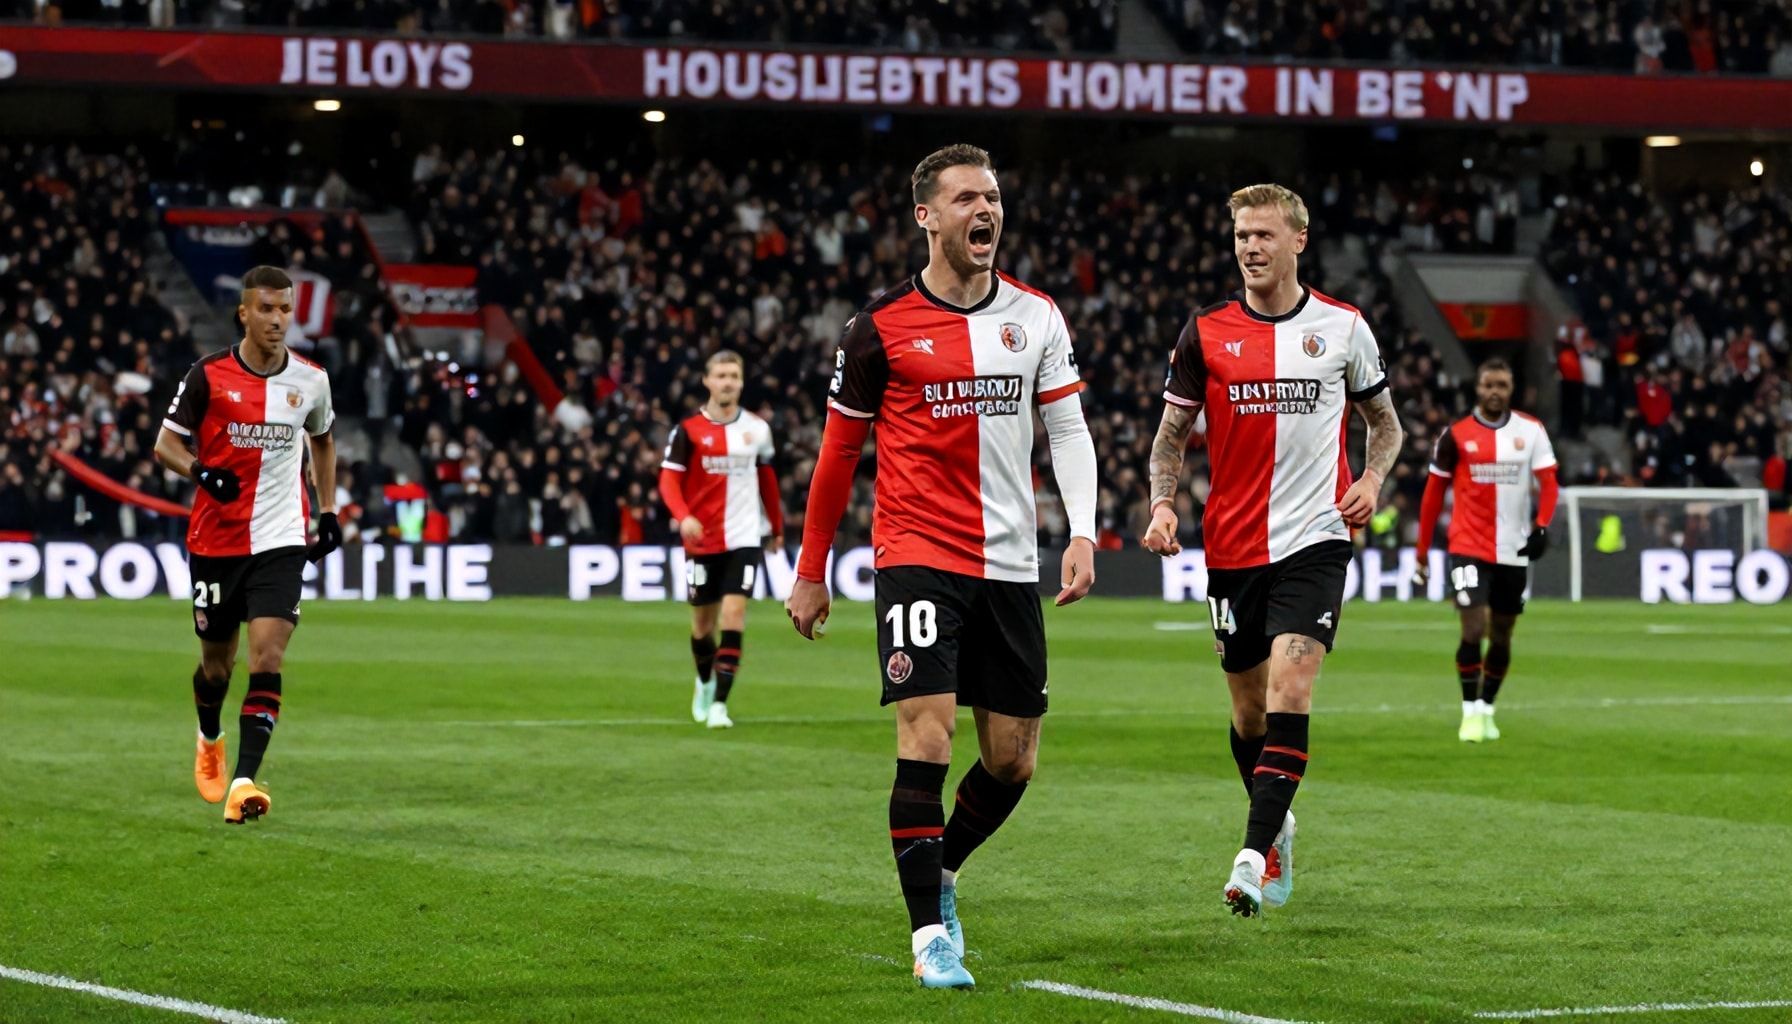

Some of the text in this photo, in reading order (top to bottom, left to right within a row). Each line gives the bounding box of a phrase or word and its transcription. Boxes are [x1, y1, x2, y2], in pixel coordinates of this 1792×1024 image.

[1046, 60, 1248, 114] HOMER
[1274, 67, 1334, 117] IN
[1355, 71, 1425, 119] BE
[193, 580, 222, 608] 21
[1639, 548, 1790, 605] REO
[885, 599, 939, 648] 10
